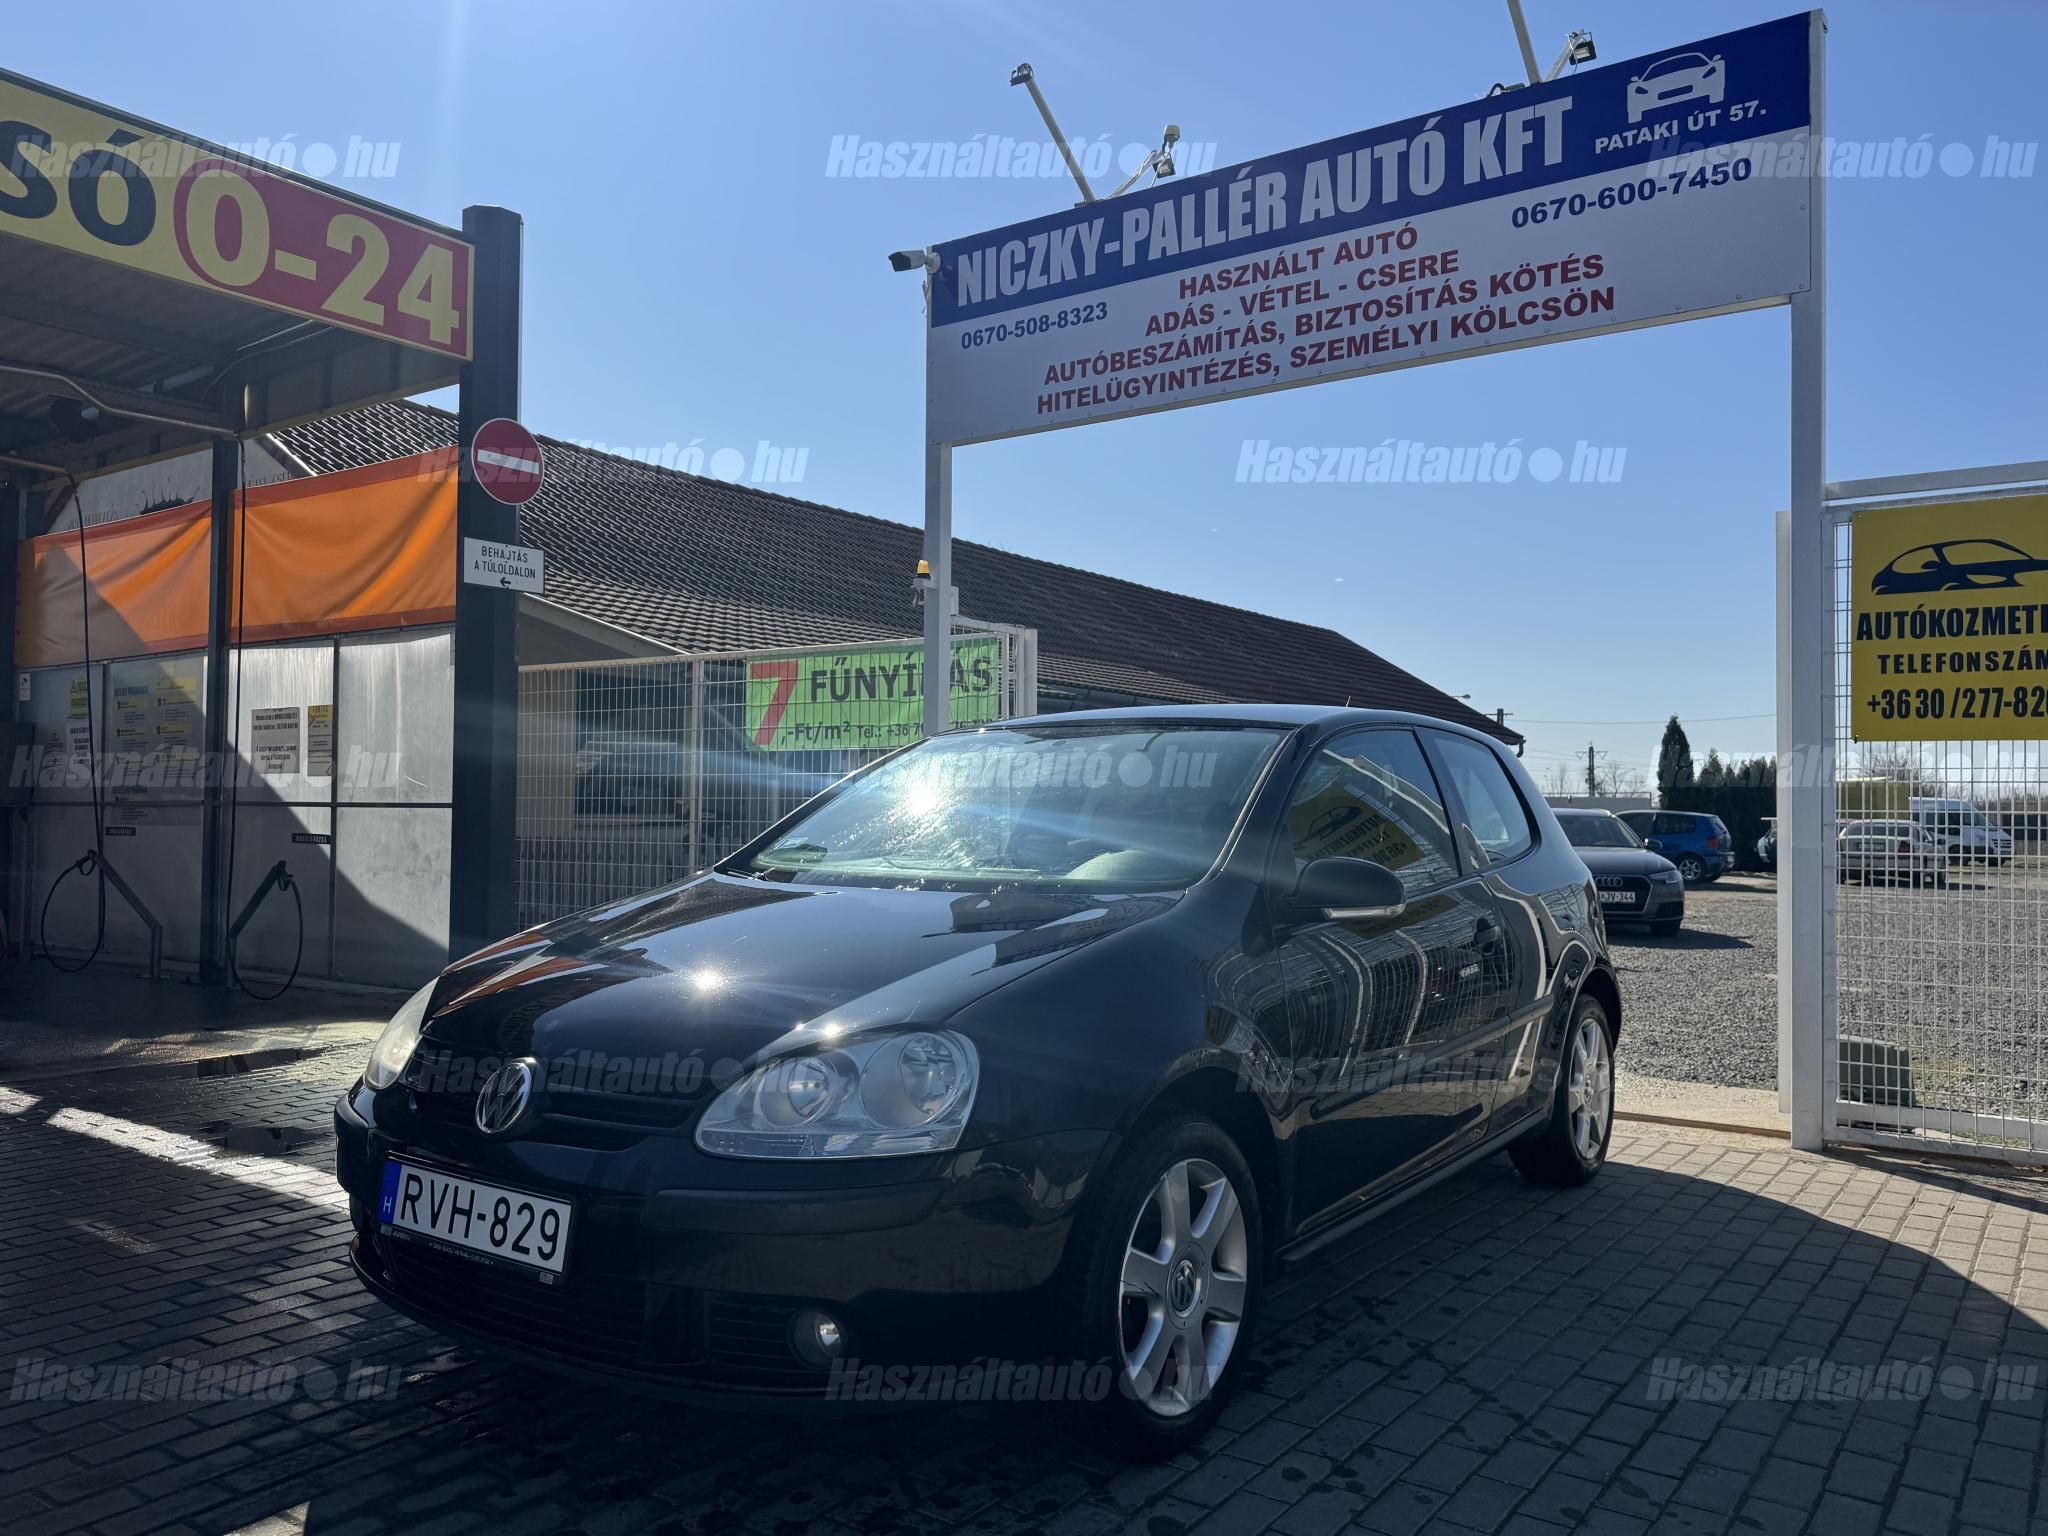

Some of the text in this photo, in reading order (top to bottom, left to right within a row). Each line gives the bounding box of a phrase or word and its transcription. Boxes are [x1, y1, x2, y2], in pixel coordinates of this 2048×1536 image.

[1595, 100, 1767, 154] PATAKI ÚT 57.
[957, 96, 1572, 307] NICZKY-PALLÉR AUTÓ KFT
[1512, 157, 1752, 228] 0670-600-7450
[186, 168, 460, 345] 0-24
[1145, 302, 1215, 336] ADÁS
[1240, 279, 1329, 316] VÉTEL
[1357, 250, 1459, 291] CSERE
[1179, 222, 1418, 299] HASZNÁLT AUTÓ
[961, 302, 1108, 349] 0670-508-8323
[1037, 287, 1614, 414] HITELÜGYINTÉZÉS, SZEMÉLYI KÖLCSÖN
[1044, 253, 1604, 385] AUTÓBESZÁMÍTÁS, BIZTOSÍTÁS KÖTÉS
[474, 559, 536, 579] A TÚLOLDALON
[481, 545, 528, 563] BEHAJTÁS
[751, 647, 993, 745] 7 FŰNYÍÁS
[383, 1196, 393, 1214] H
[400, 1173, 560, 1260] RVH-829
